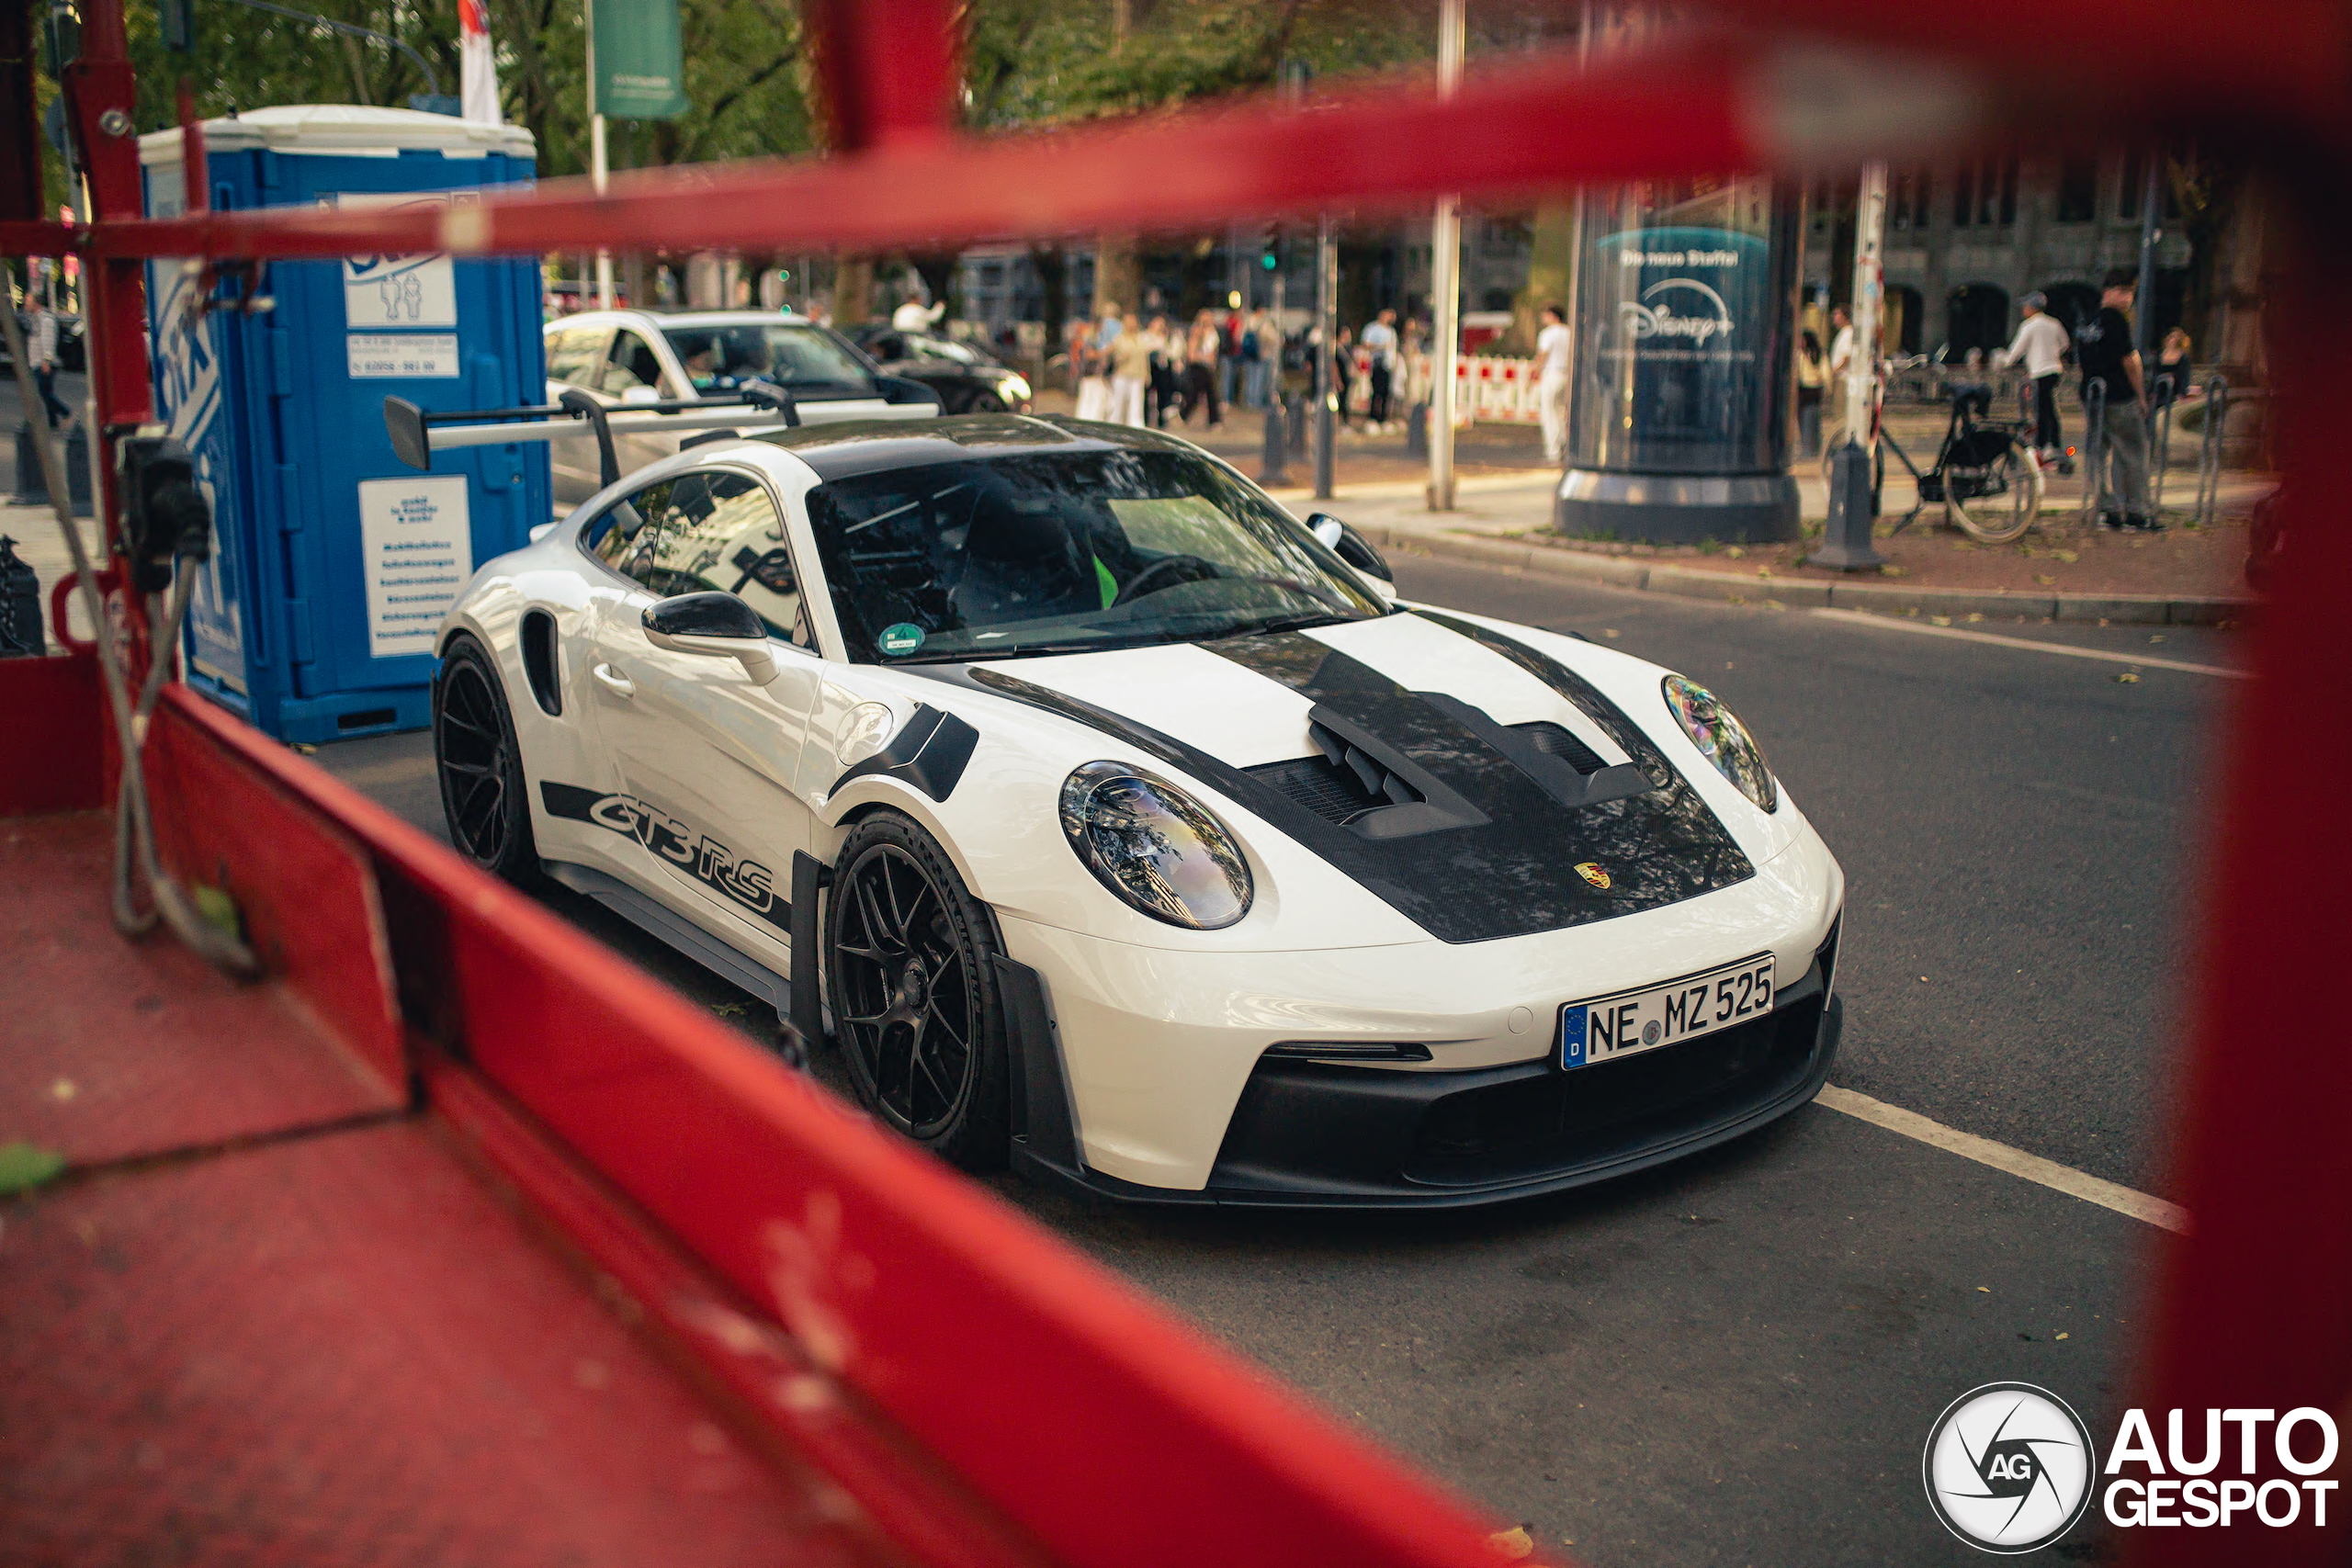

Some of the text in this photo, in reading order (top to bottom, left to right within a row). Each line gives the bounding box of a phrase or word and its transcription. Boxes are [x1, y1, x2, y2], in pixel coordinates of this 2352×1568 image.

[1646, 252, 1685, 267] neue
[1687, 248, 1739, 267] Staffel
[897, 627, 907, 639] 4
[1590, 965, 1771, 1055] NE MZ 525
[1570, 1043, 1579, 1056] D
